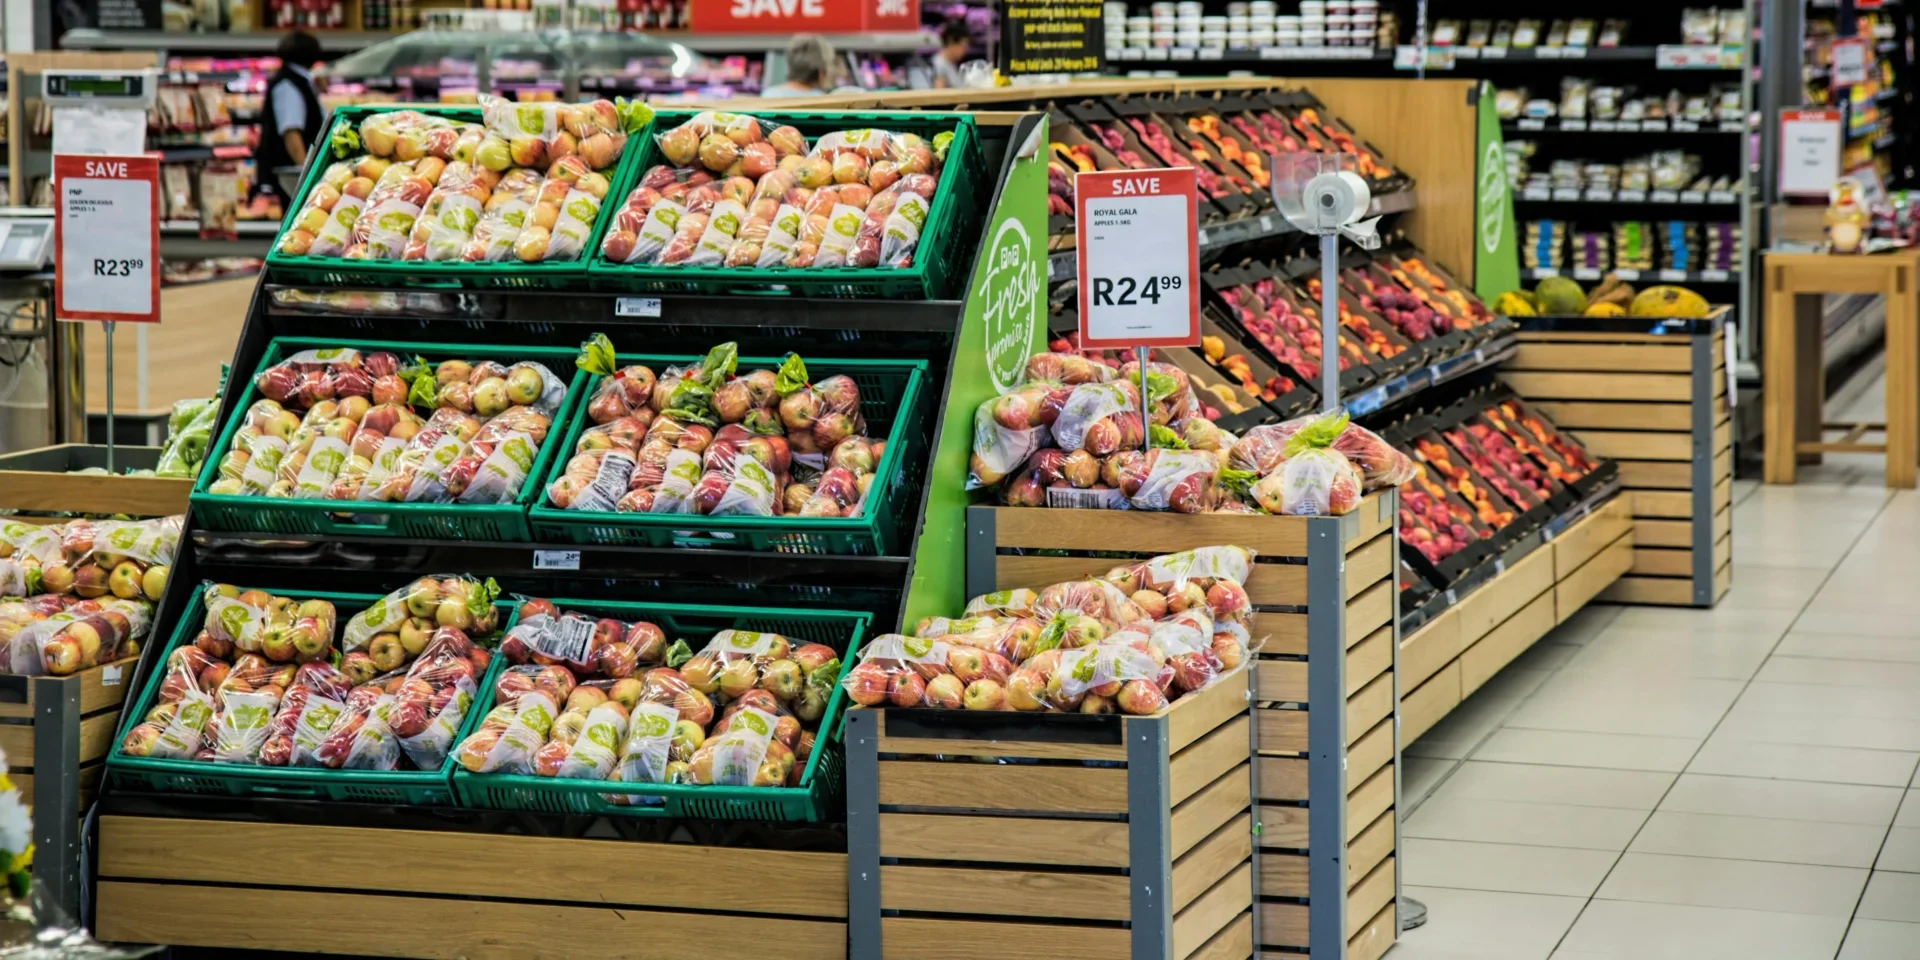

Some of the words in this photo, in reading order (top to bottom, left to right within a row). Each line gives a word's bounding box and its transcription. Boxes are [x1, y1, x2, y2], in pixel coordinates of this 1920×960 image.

[85, 161, 128, 178] SAVE
[69, 188, 82, 196] PNP
[1112, 177, 1160, 195] SAVE
[1094, 208, 1117, 217] ROYAL
[1118, 208, 1138, 216] GALA
[978, 235, 1041, 334] Fresh
[991, 322, 1023, 361] promise
